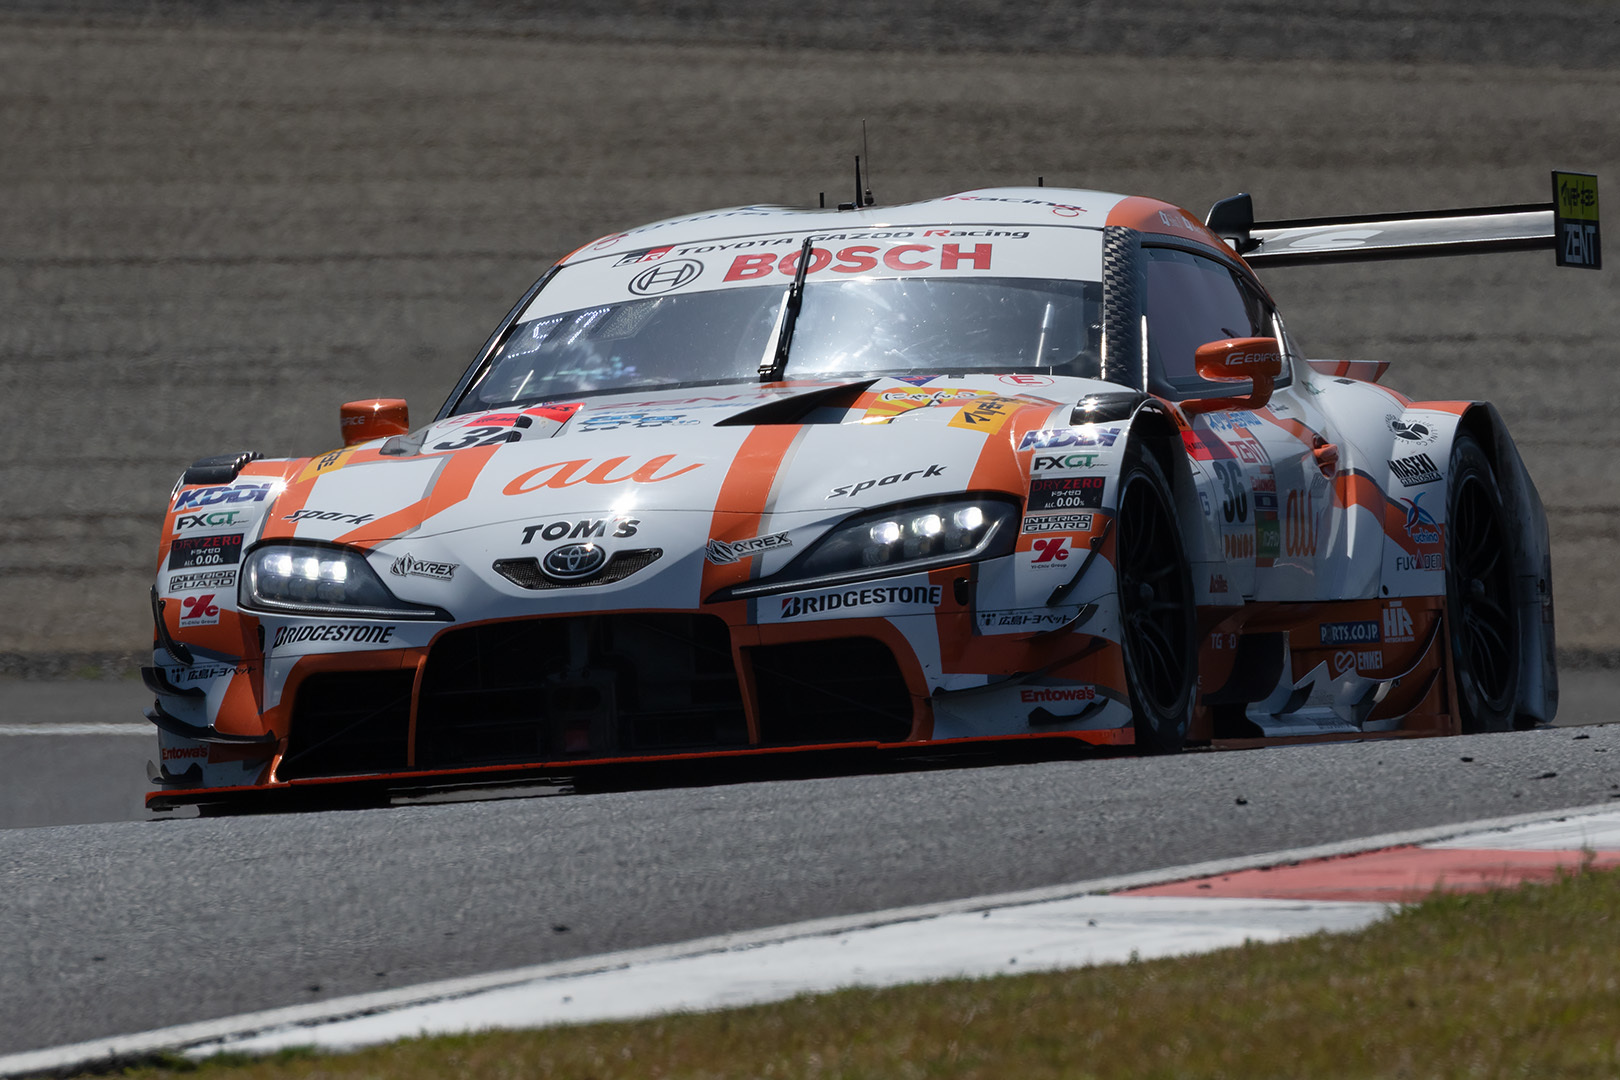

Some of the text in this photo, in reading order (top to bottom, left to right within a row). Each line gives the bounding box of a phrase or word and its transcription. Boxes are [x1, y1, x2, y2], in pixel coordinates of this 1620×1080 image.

[676, 228, 1030, 256] TOYOTA GAZOO Racing
[1563, 223, 1596, 265] ZENT
[722, 243, 993, 283] BOSCH
[1227, 439, 1268, 463] ZENT
[1033, 454, 1099, 471] FXGT
[1387, 453, 1438, 479] MASEKI
[502, 454, 705, 496] au
[825, 464, 947, 500] spark
[1400, 472, 1442, 486] GEINOSHA
[172, 482, 273, 512] KDDI
[1212, 460, 1247, 523] 36
[176, 510, 240, 530] FXGT
[283, 508, 377, 525] spark
[1025, 514, 1091, 524] INTERIOR
[1286, 489, 1319, 557] au
[521, 518, 641, 545] TOM'S
[1025, 522, 1090, 532] GUARD
[1412, 527, 1439, 543] uchino
[171, 570, 235, 583] INTERIOR
[171, 578, 233, 590] GUARD
[781, 586, 941, 618] BRIDGESTONE
[998, 614, 1072, 626] 広島トヨペット
[272, 625, 395, 649] BRIDGESTONE
[1211, 633, 1237, 649] TG-D
[1357, 650, 1383, 670] ENKEI
[187, 666, 257, 681] 広島トヨペット
[1020, 686, 1095, 703] Entowa's
[162, 745, 209, 761] Entowa's
